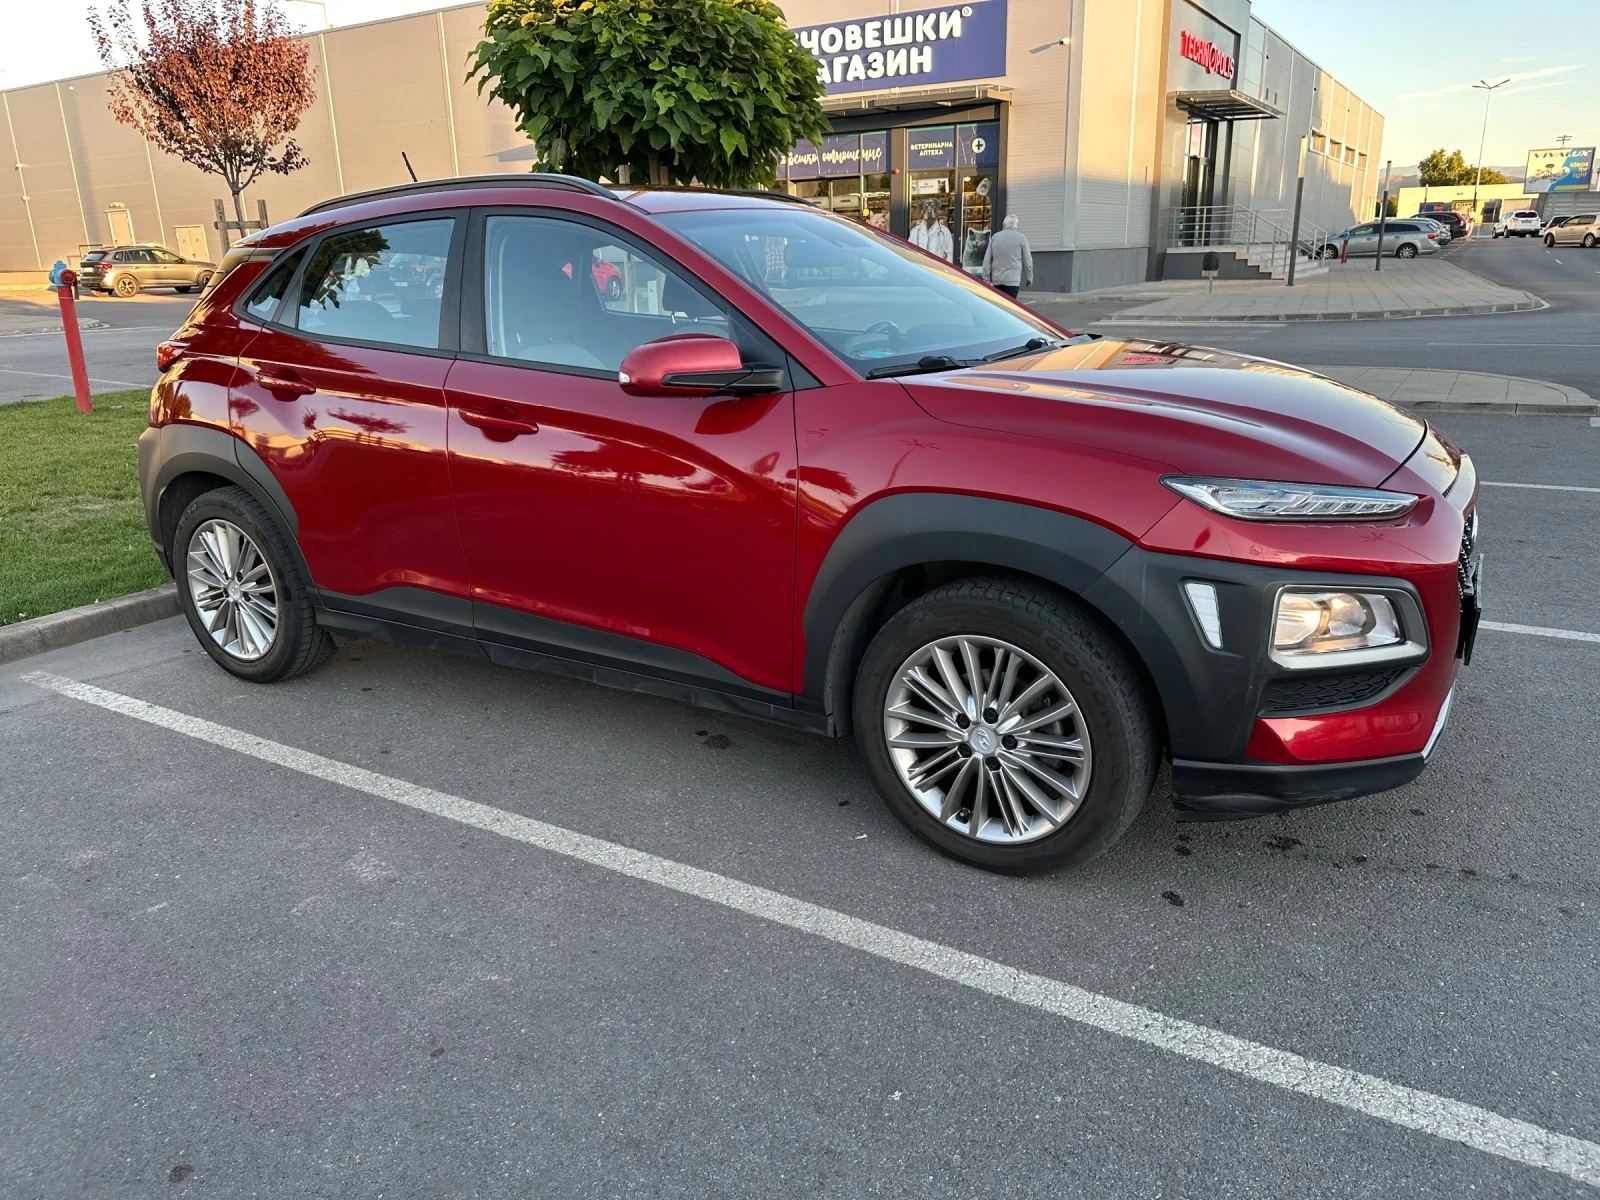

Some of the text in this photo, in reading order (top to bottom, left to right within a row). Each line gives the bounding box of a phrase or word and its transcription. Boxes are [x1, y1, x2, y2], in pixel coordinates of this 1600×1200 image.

[816, 45, 932, 84] АГАЗИН
[1180, 30, 1235, 79] TECHNOPOLIS
[910, 141, 954, 150] ВЕТЕРИНАРНА
[1534, 150, 1592, 158] VIVALUX
